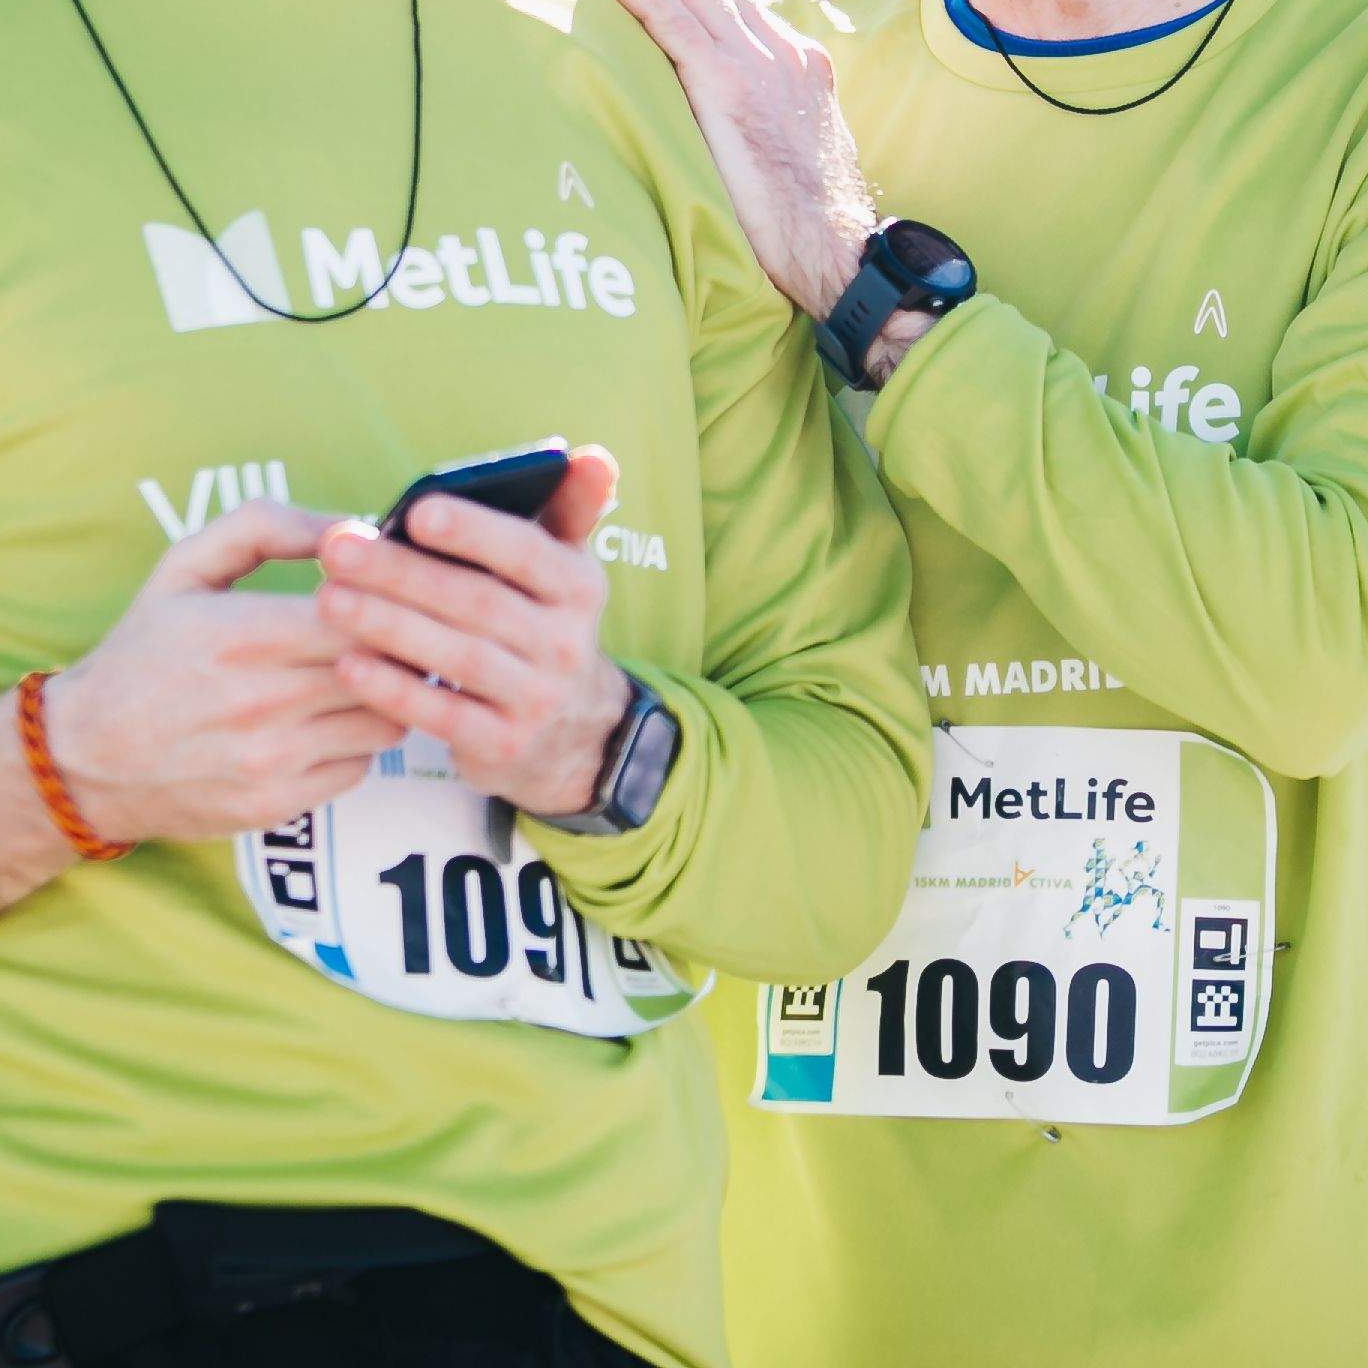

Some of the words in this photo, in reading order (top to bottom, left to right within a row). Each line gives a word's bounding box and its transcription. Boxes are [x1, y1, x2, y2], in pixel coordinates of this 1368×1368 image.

[301, 227, 636, 317] MetLife
[1093, 365, 1242, 442] ife
[594, 504, 668, 572] CTIVA
[949, 776, 1156, 823] MetLife
[956, 876, 1012, 889] MADRID
[866, 957, 1138, 1085] 1090
